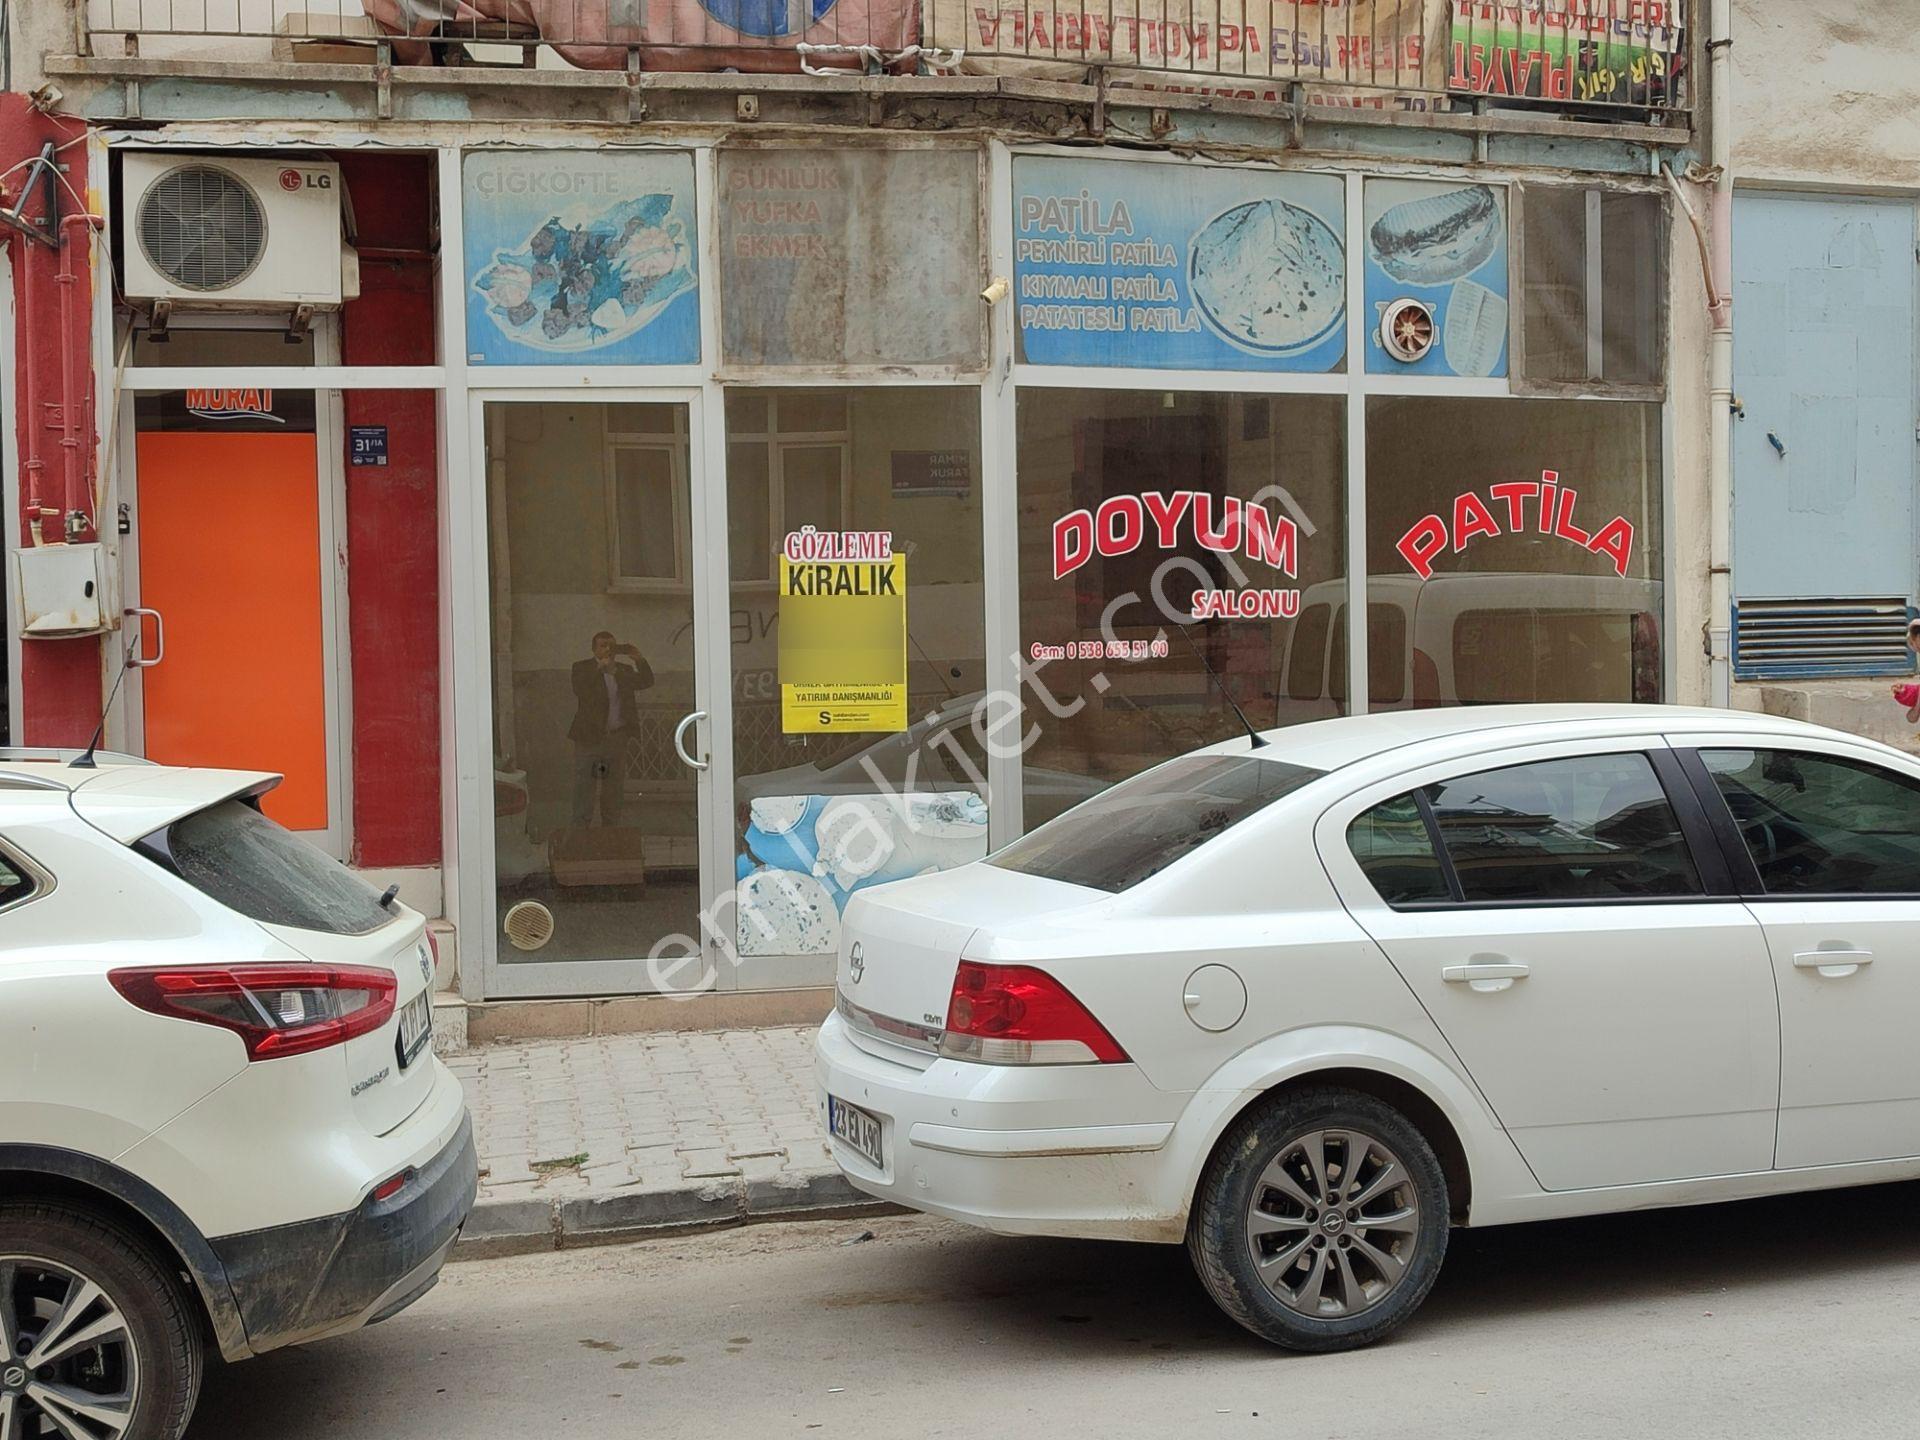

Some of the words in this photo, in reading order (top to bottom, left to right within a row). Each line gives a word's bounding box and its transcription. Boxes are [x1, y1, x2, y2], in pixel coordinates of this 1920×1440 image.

[974, 8, 1209, 60] KOLLARIYLA
[1450, 40, 1574, 100] PLAYST
[306, 174, 331, 189] LG
[727, 162, 839, 191] GÜNLÜK
[734, 199, 823, 226] YUFKA
[1020, 188, 1134, 236] PATİLA
[735, 232, 828, 259] EKMEK
[1017, 236, 1106, 265] PEYNİRLİ
[1111, 237, 1177, 267] PATİLA
[1022, 274, 1107, 300] KIYMALI
[1112, 273, 1178, 301] PATİLA
[1053, 491, 1297, 581] DOYUM
[1395, 469, 1634, 581] PATİLA
[784, 525, 892, 563] GÖZLEME
[1191, 588, 1300, 618] SALONU
[1031, 642, 1064, 660] Gsm:
[1066, 641, 1076, 660] 0
[1079, 640, 1103, 659] 538
[1106, 640, 1130, 659] 655
[1132, 640, 1148, 658] 51
[1151, 640, 1169, 658] 90
[795, 692, 830, 702] YATIRIM
[832, 690, 893, 703] DANIŞMANLIĞI
[819, 711, 831, 725] S
[835, 1101, 847, 1137] 23
